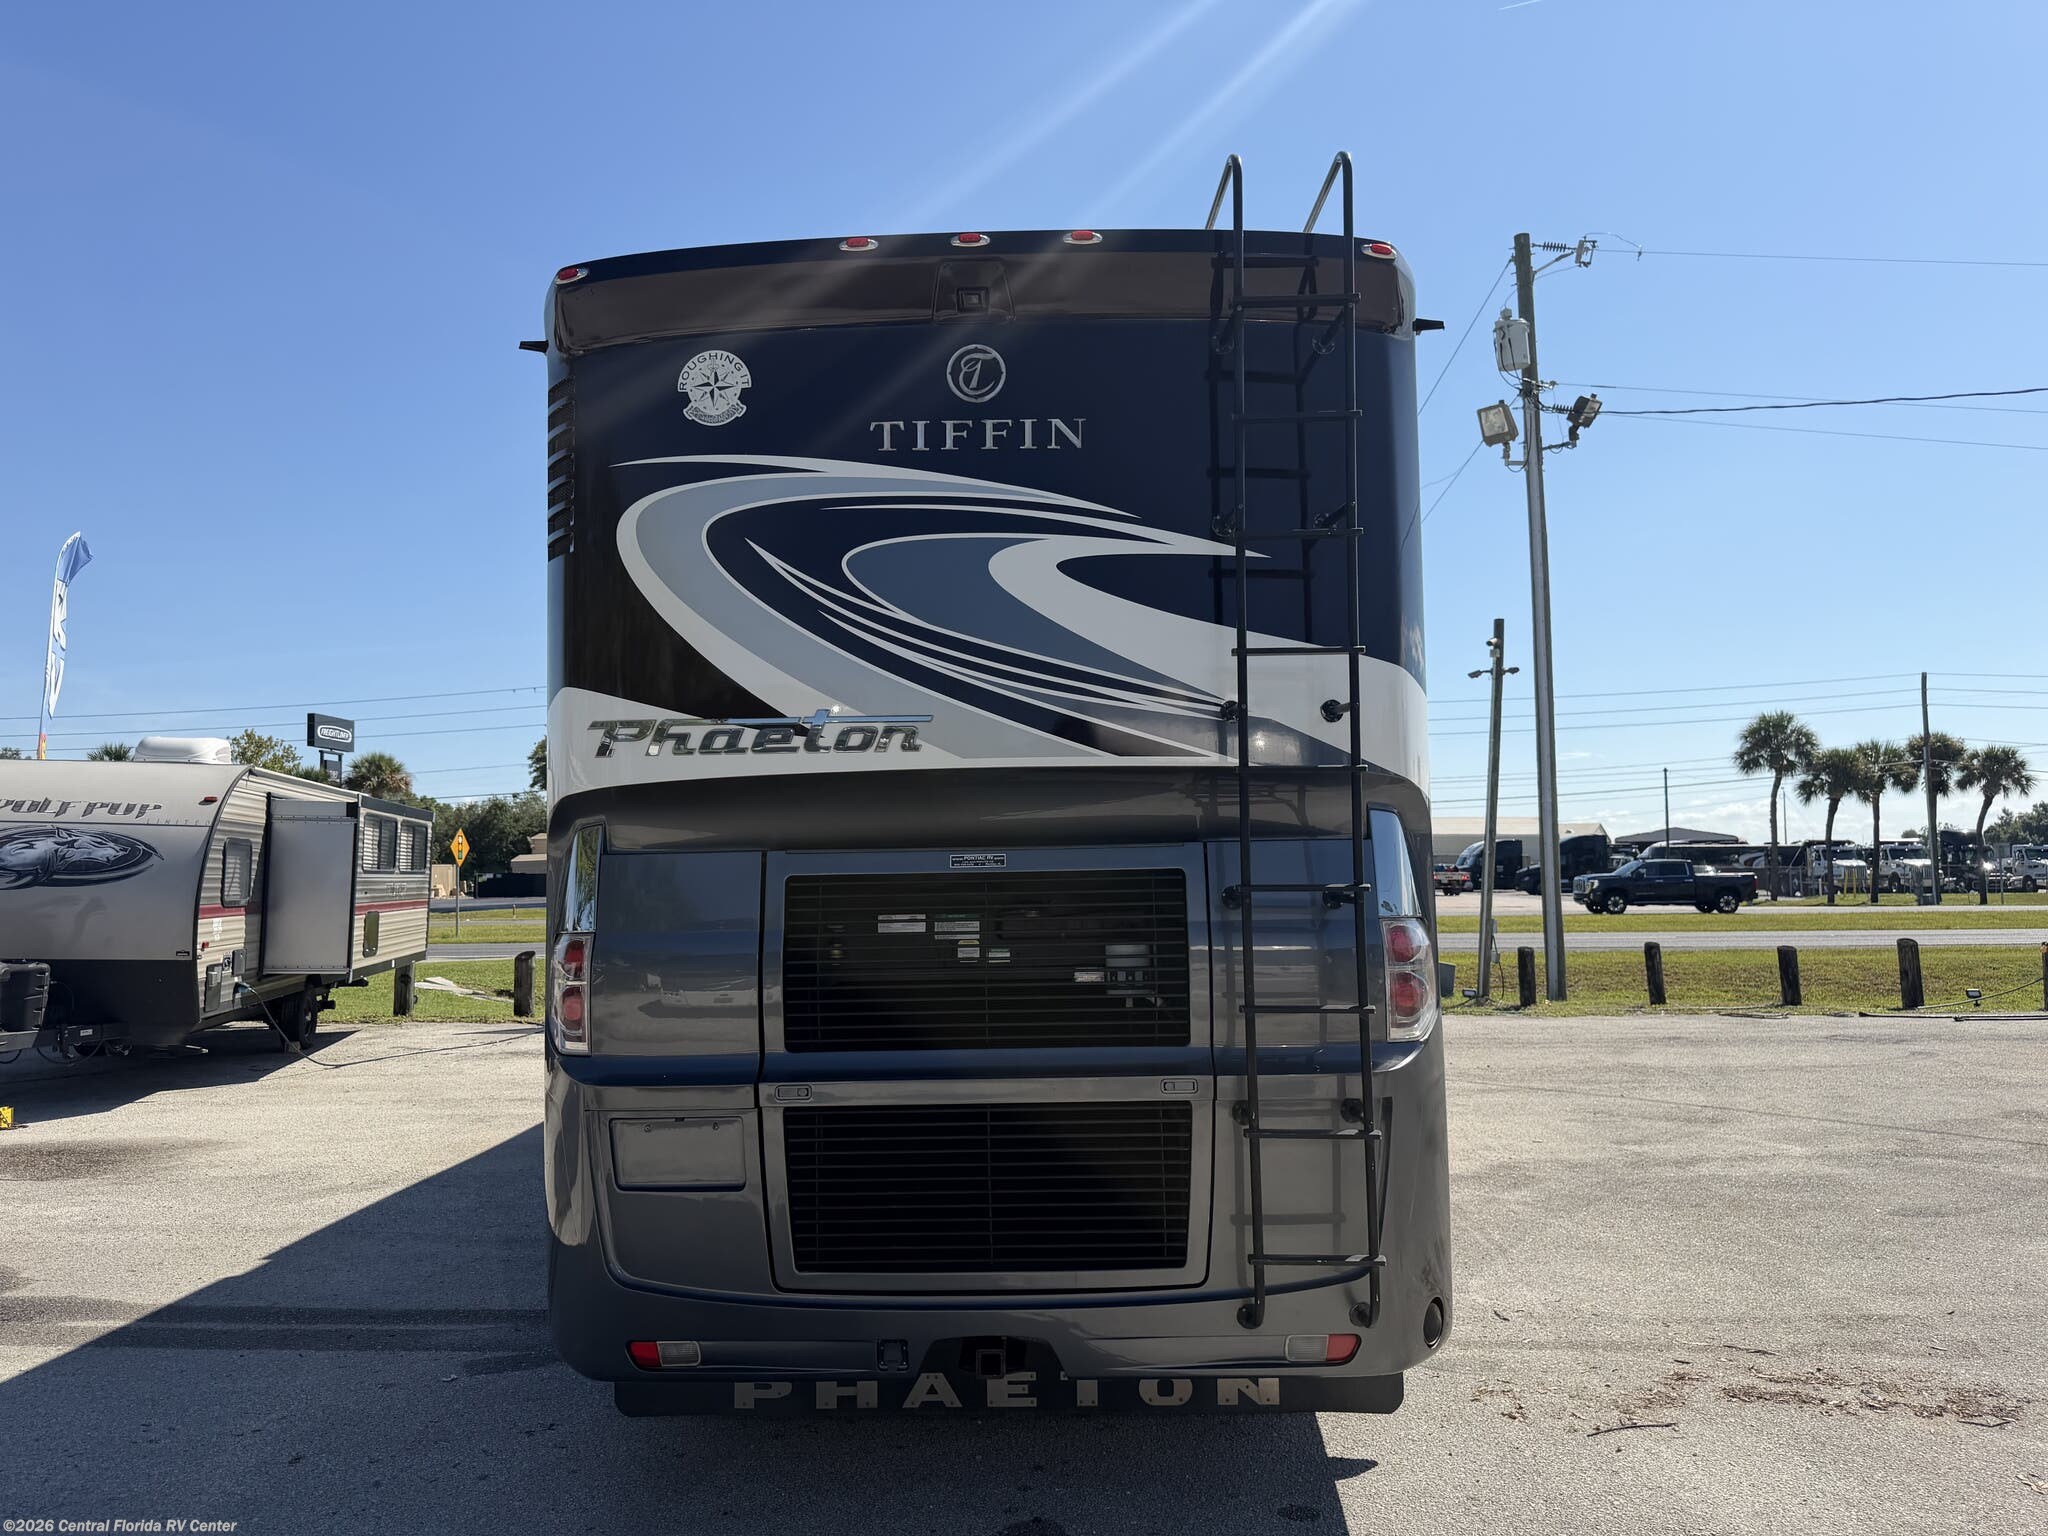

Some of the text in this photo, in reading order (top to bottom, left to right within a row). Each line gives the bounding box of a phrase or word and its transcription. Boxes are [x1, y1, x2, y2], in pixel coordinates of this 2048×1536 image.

[679, 352, 751, 391] ROUGHING IT
[869, 418, 1087, 451] TIFFIN
[320, 727, 349, 740] FREIGHTLINER
[587, 709, 934, 759] Phaeton
[80, 800, 162, 819] PUP
